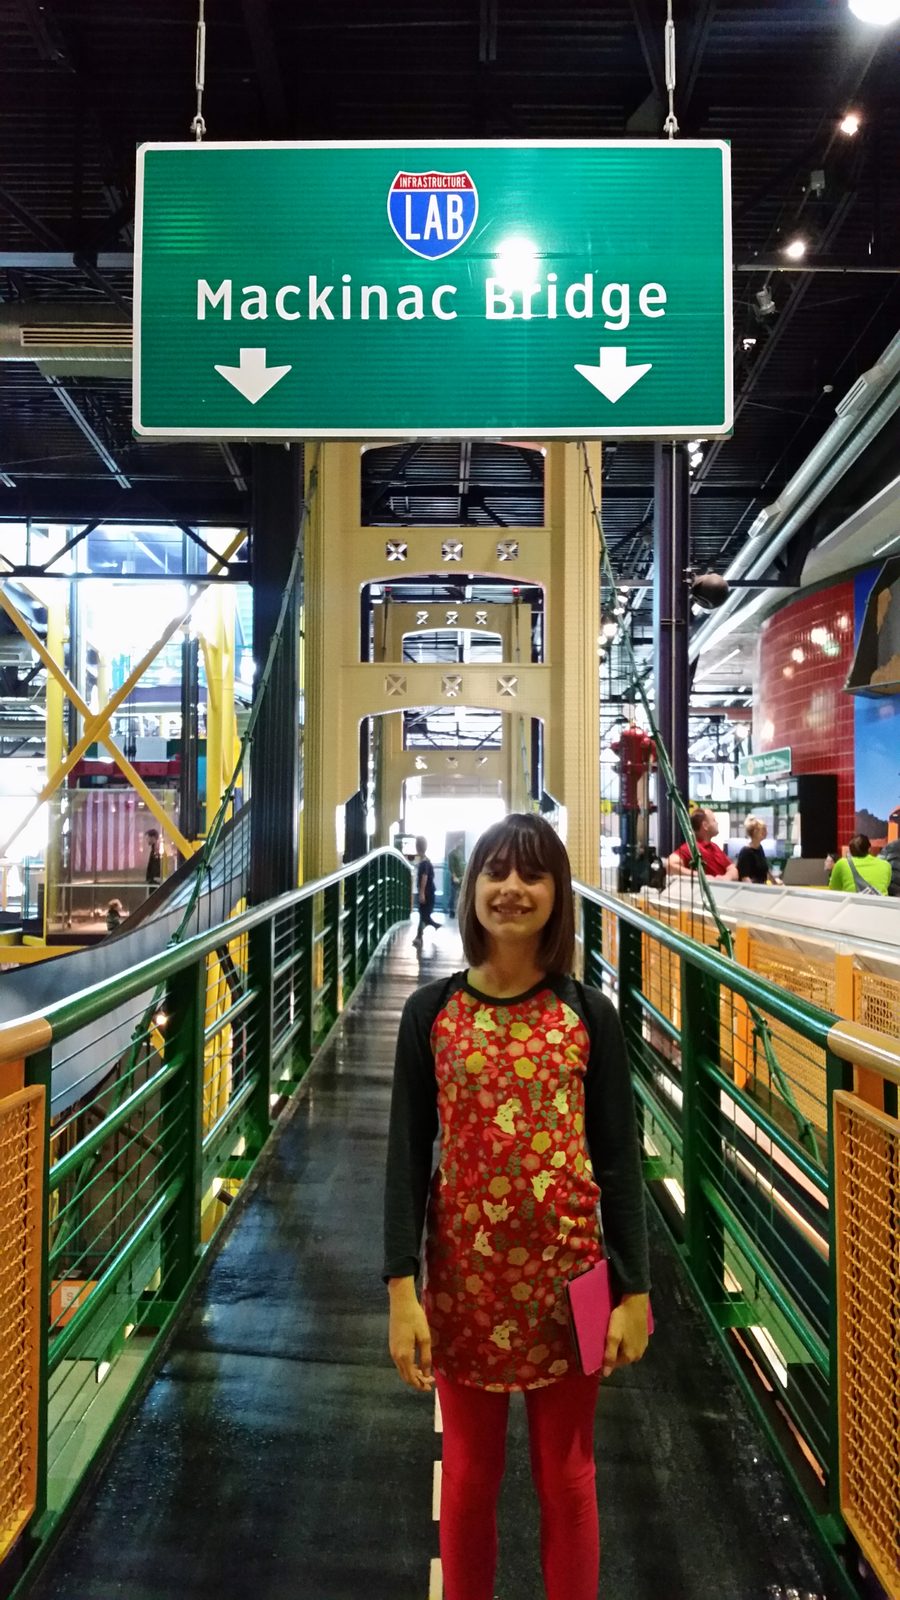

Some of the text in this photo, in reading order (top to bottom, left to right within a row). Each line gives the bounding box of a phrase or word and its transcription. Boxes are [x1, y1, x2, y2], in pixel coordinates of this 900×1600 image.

[399, 176, 467, 188] INFRASTRUCTURE
[405, 194, 464, 241] LAB
[196, 272, 668, 330] Mackinac Bridge
